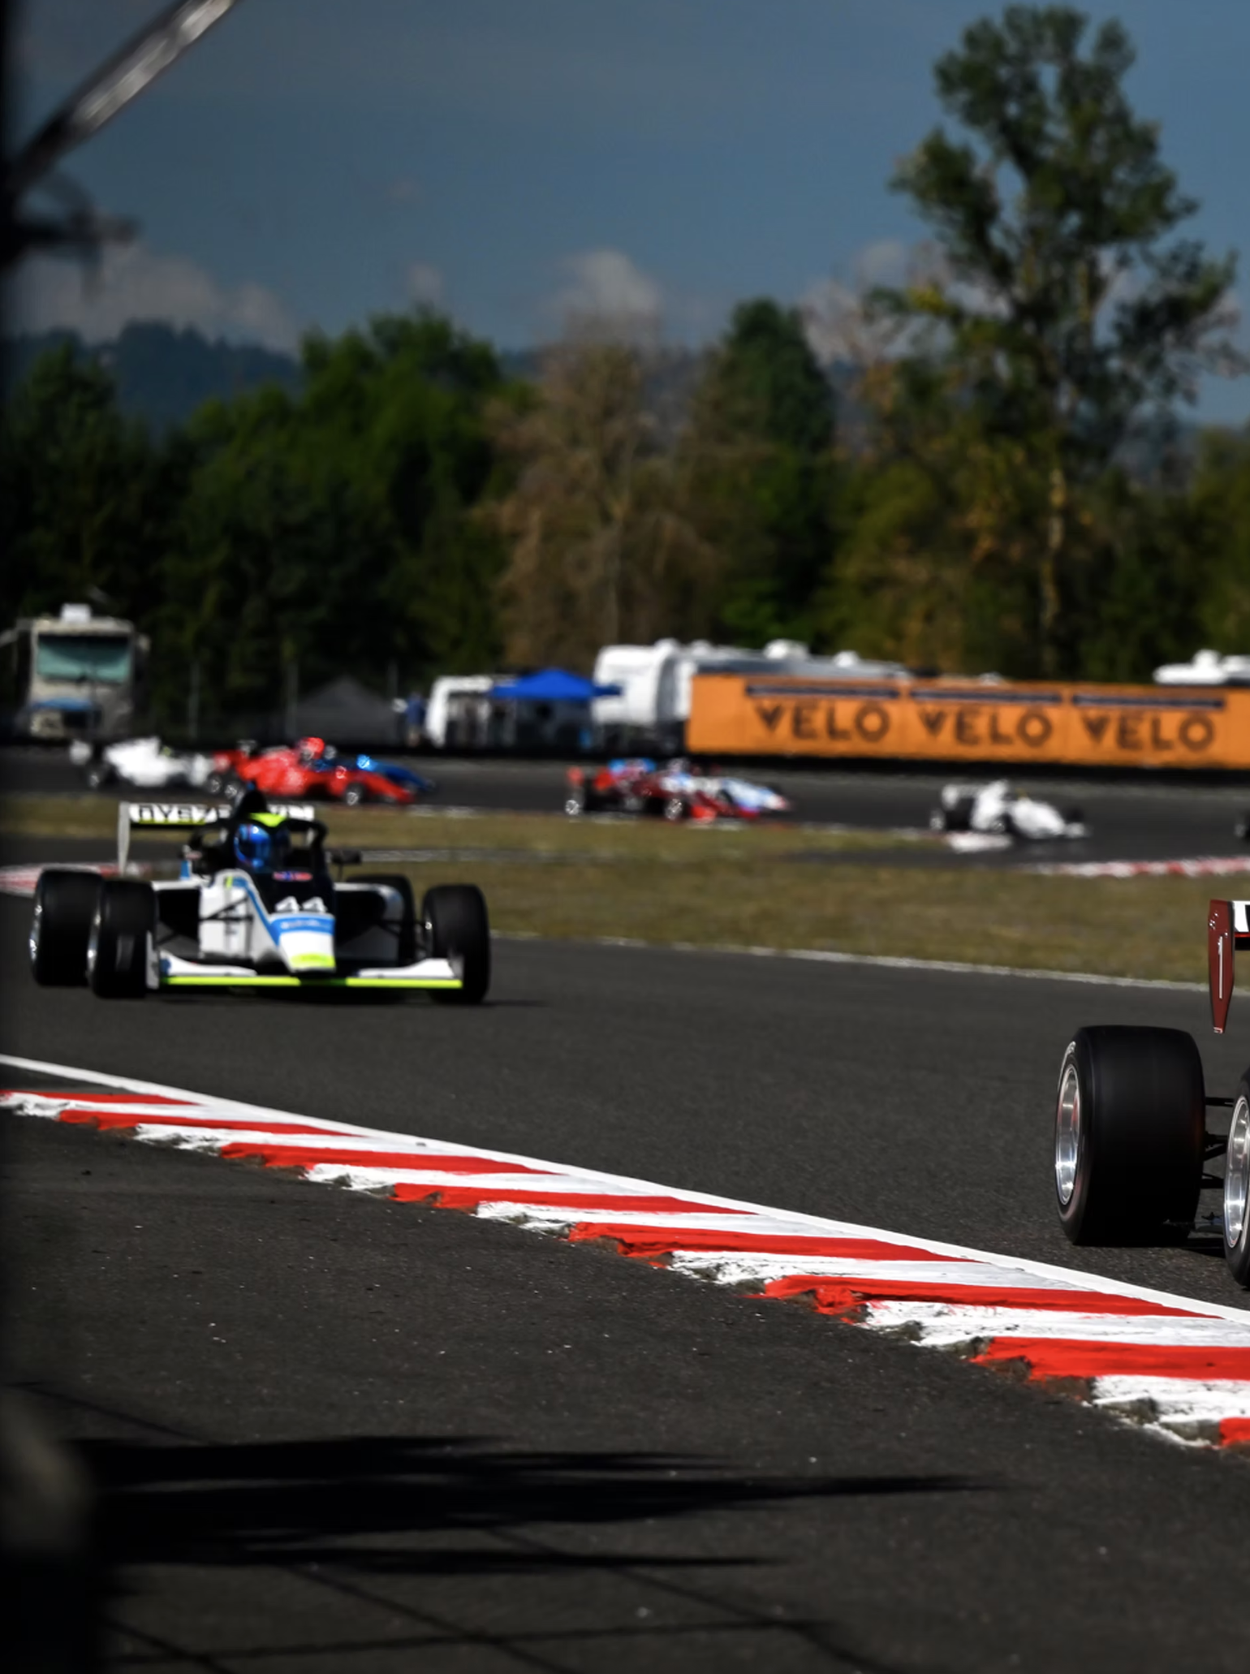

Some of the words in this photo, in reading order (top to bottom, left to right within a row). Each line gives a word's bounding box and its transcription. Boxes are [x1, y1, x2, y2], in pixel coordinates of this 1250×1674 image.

[754, 701, 891, 744] VELO
[913, 704, 1053, 747] VELO
[1081, 708, 1216, 752] VELO
